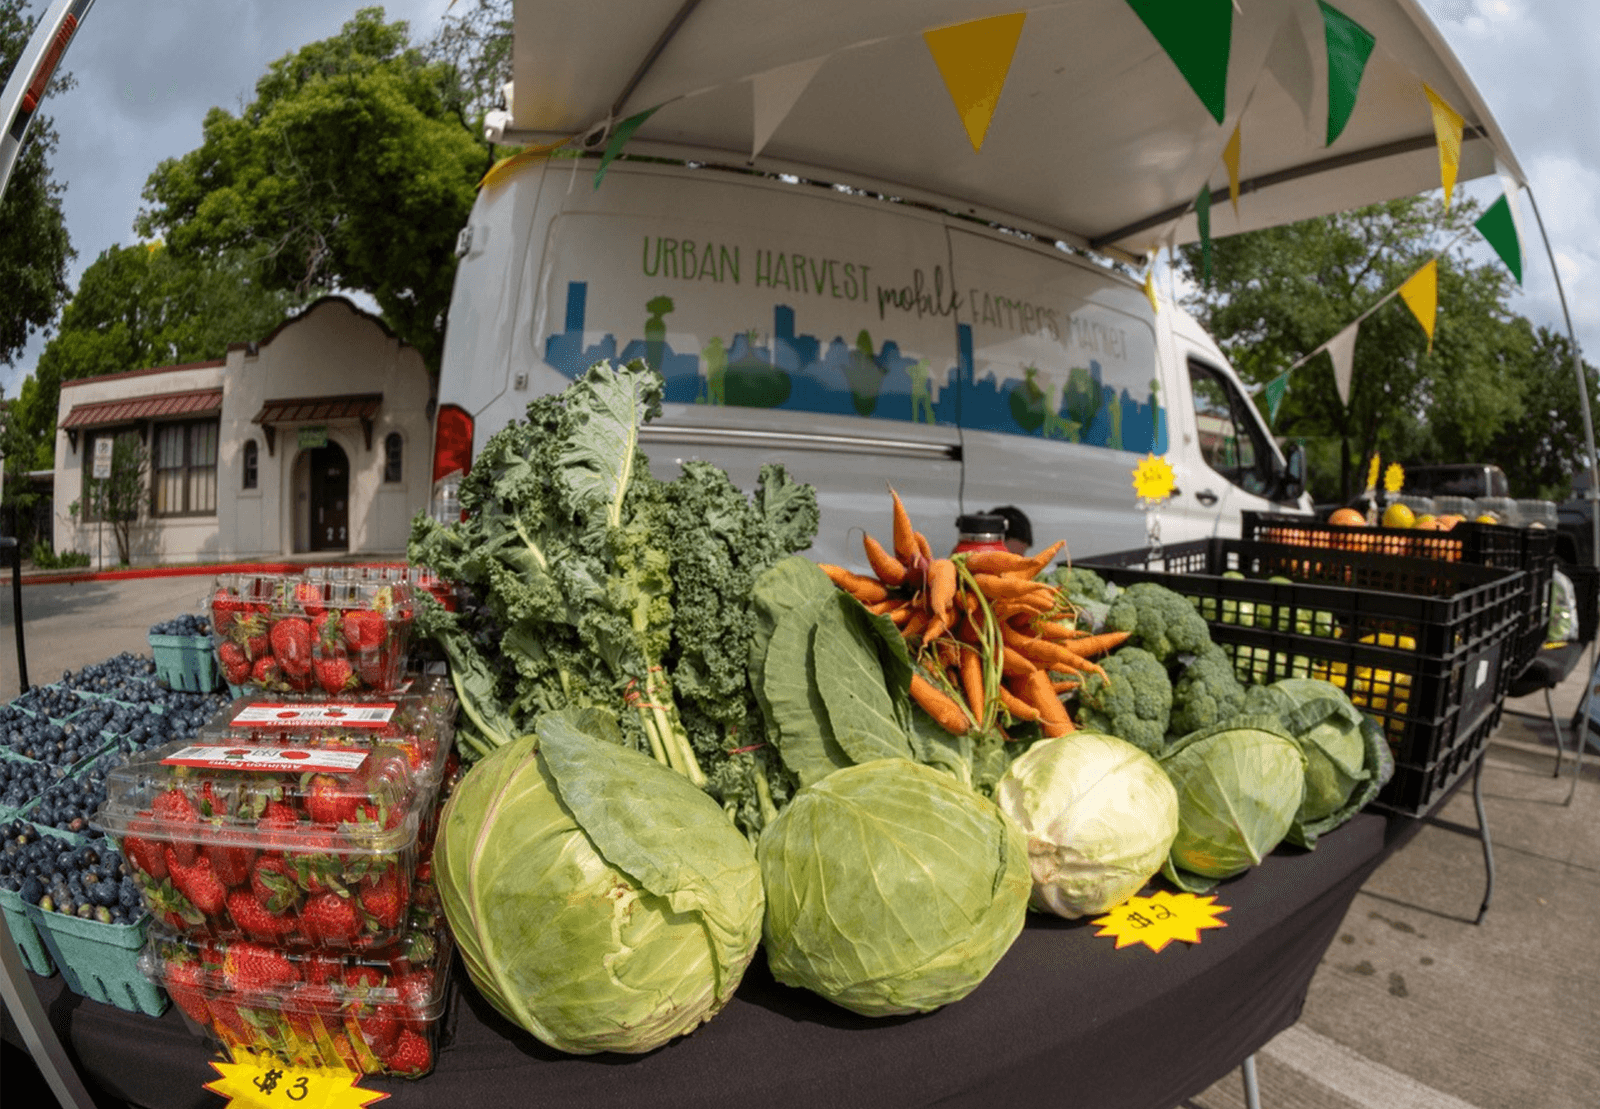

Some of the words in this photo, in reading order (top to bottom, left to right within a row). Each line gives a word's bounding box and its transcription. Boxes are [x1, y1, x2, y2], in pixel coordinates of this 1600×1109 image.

[642, 235, 741, 285] URBAN
[755, 249, 871, 303] HARVEST
[877, 264, 963, 321] mobile
[1126, 903, 1178, 929] $2
[252, 1068, 309, 1102] $3
